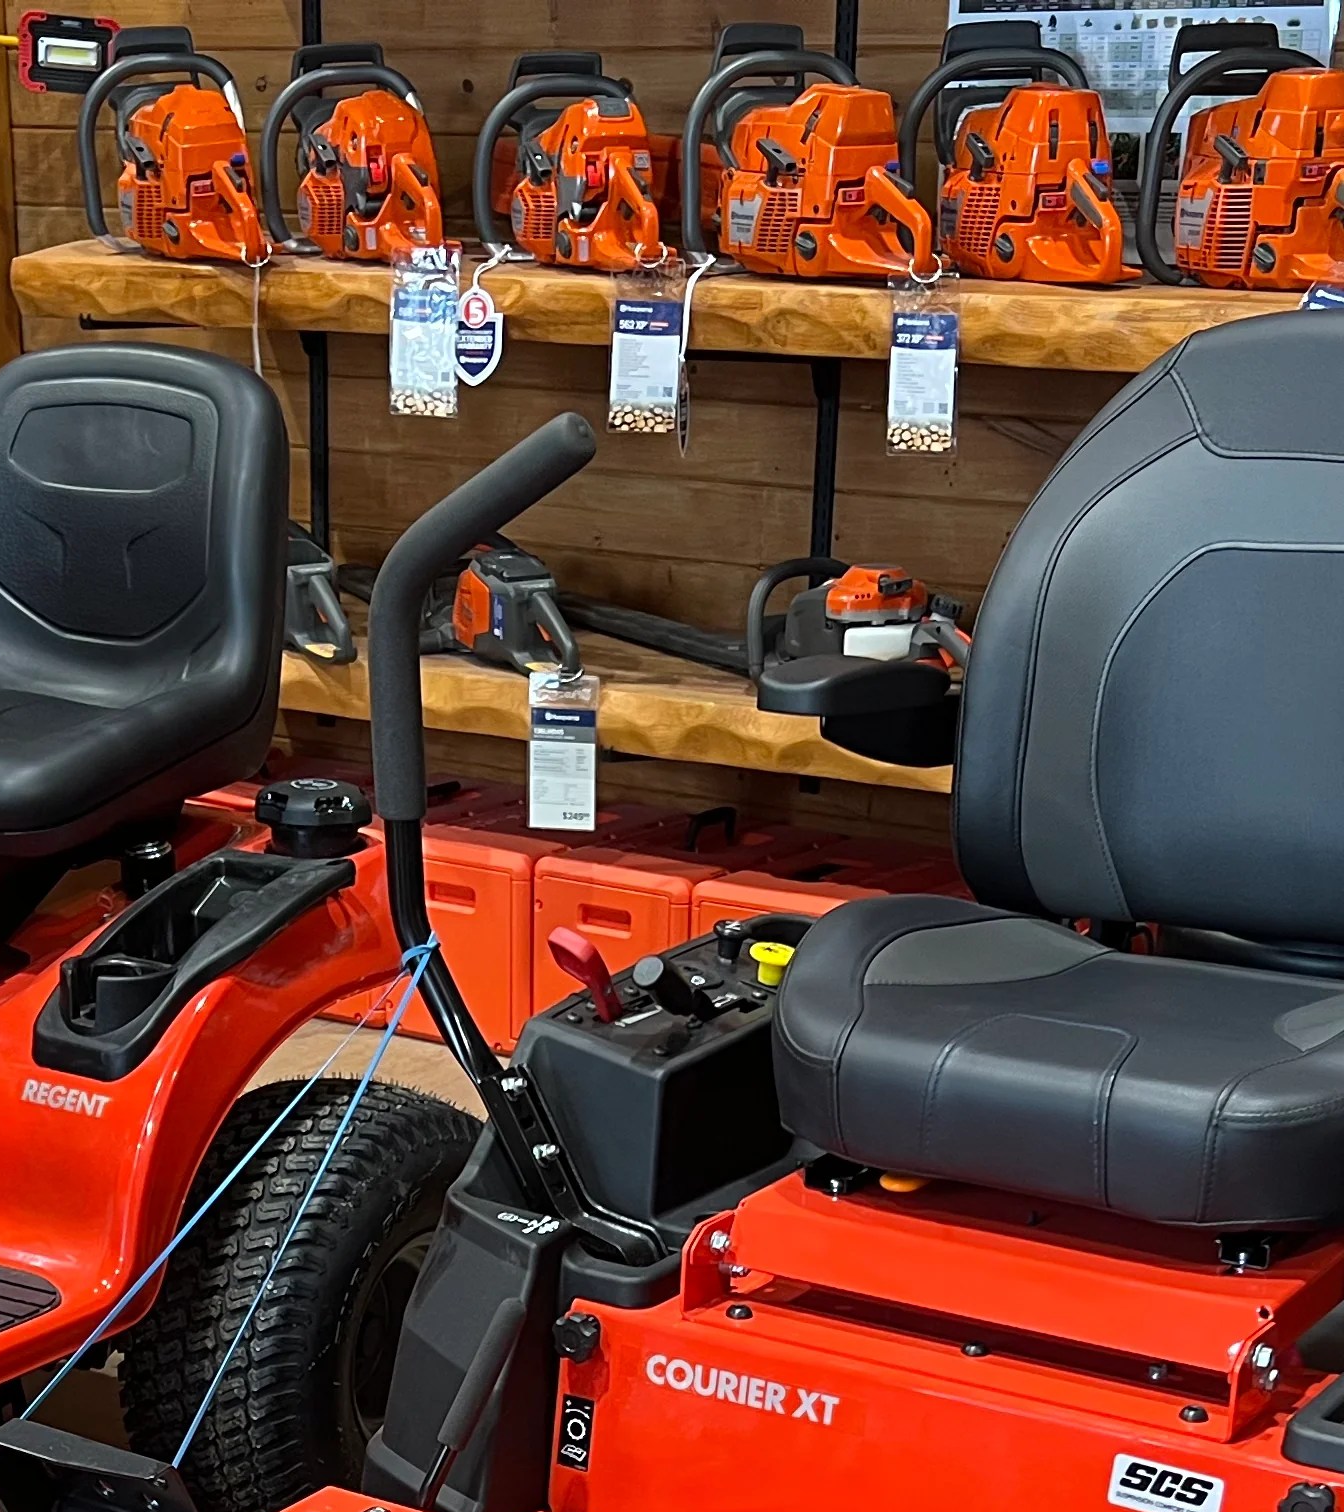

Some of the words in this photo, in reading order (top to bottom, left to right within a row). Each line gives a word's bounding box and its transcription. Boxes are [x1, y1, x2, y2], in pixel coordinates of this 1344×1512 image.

[468, 299, 485, 324] 5
[21, 1079, 113, 1118] REGENT
[646, 1354, 786, 1415] COURIER
[792, 1388, 840, 1426] XT
[1119, 1462, 1214, 1507] SCS
